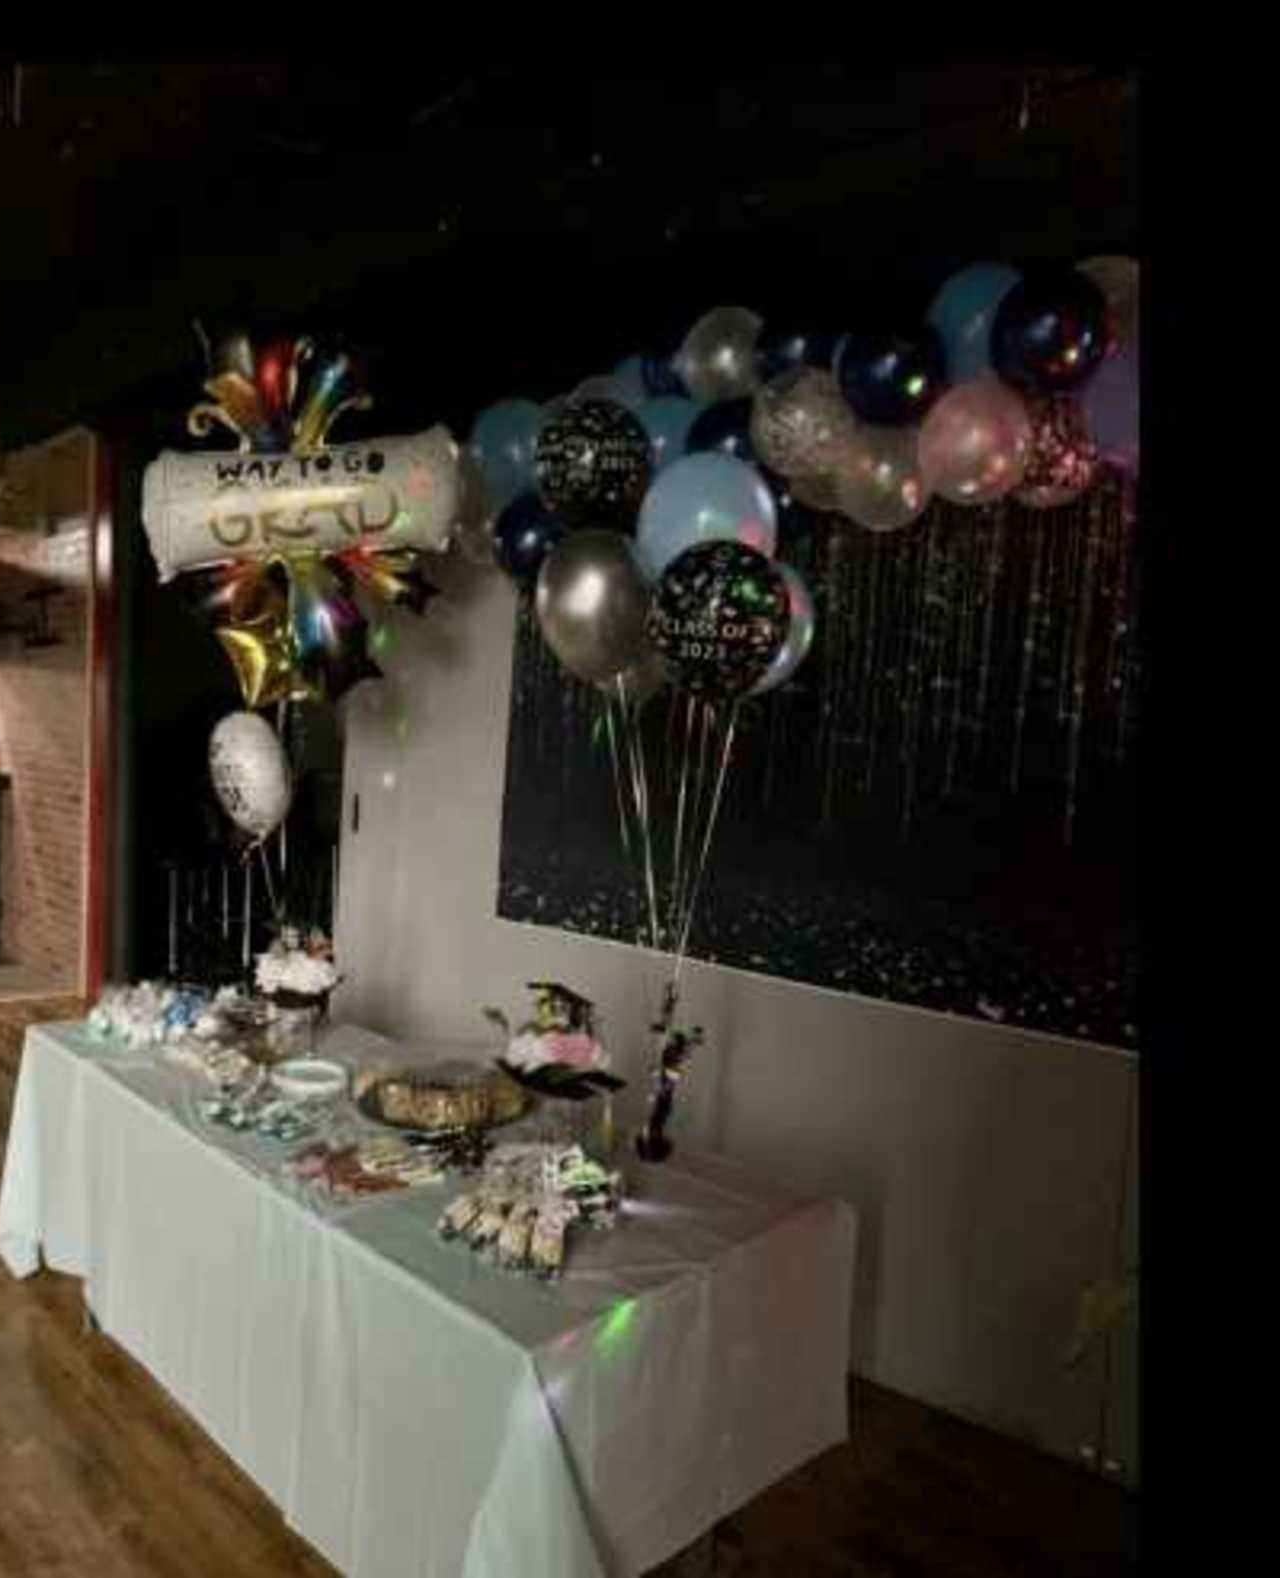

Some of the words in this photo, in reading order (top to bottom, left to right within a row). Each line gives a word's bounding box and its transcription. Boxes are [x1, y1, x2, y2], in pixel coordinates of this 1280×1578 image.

[217, 460, 281, 479] WAY
[294, 456, 333, 478] TO
[343, 452, 385, 474] GO
[663, 619, 717, 637] CLASS
